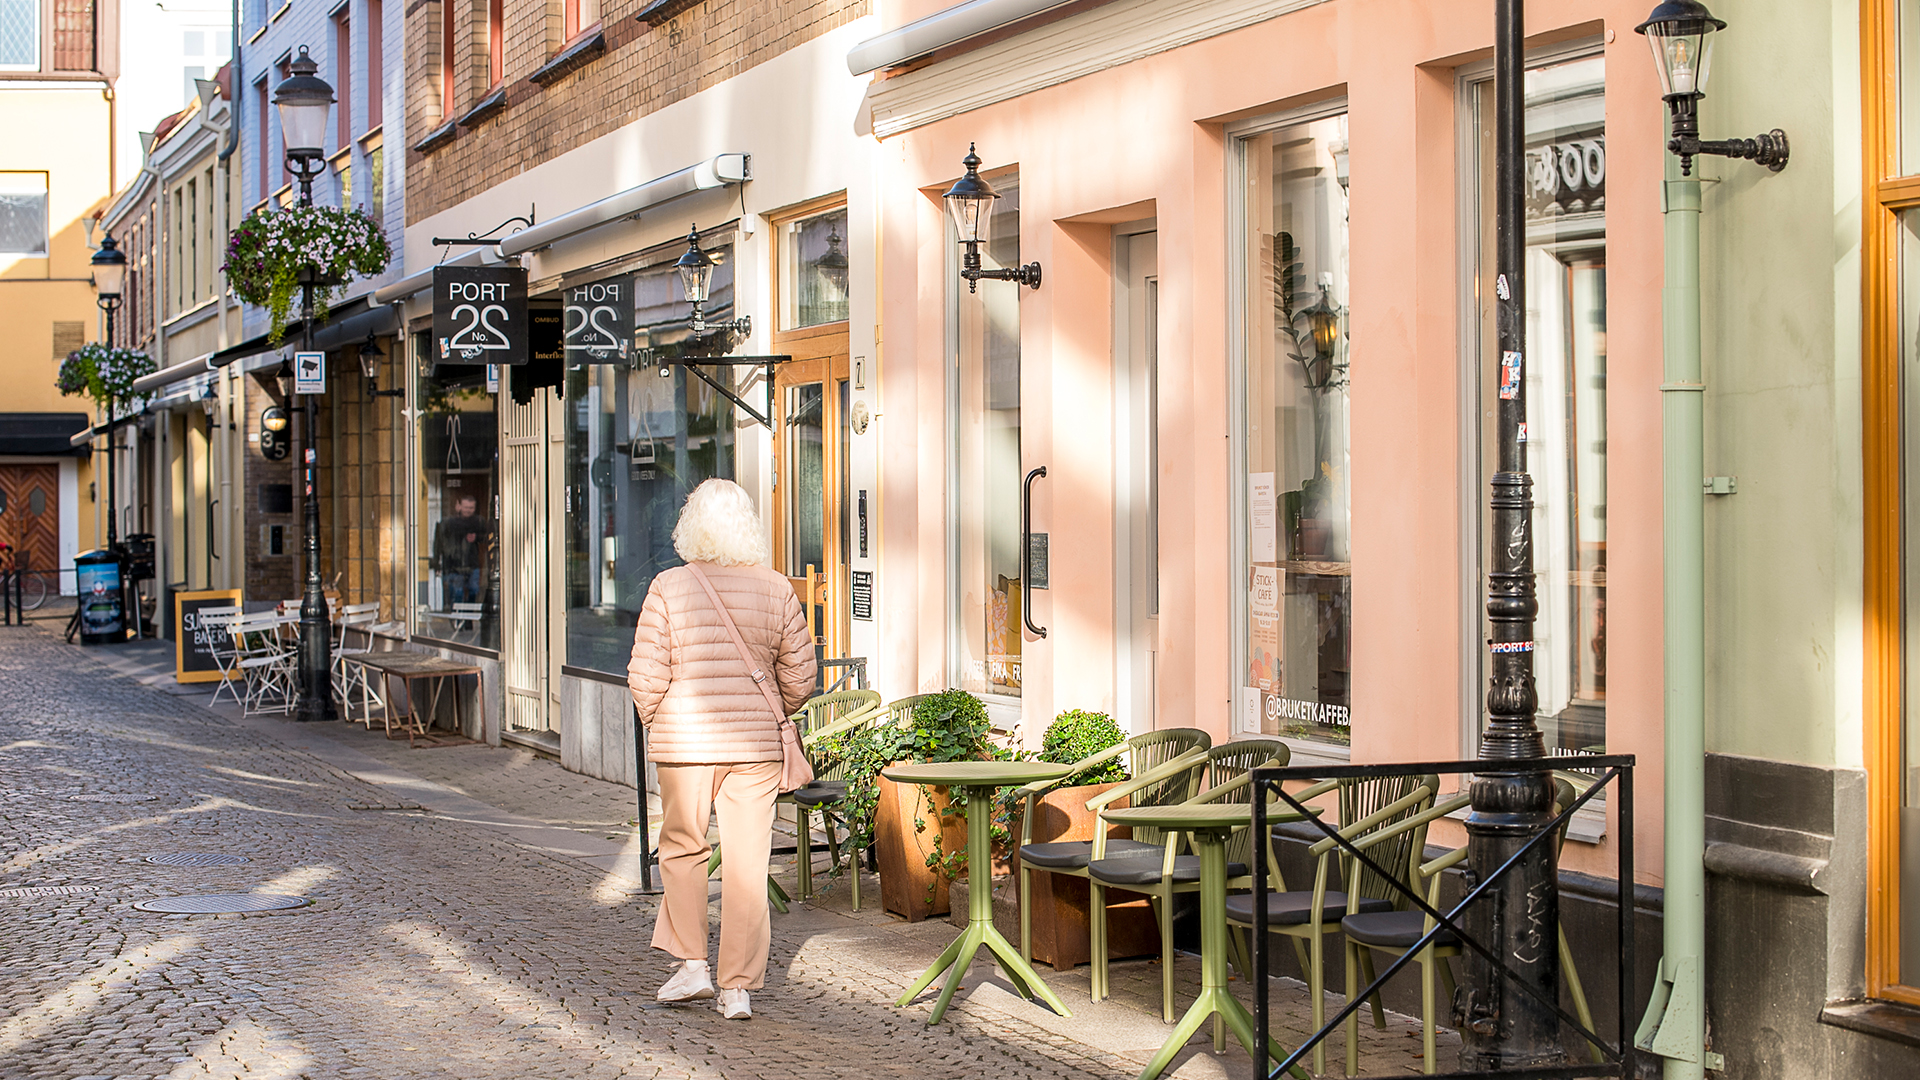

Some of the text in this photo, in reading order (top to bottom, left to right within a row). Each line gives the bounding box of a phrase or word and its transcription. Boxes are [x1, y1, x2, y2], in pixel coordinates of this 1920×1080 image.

[449, 282, 511, 301] PORT
[471, 332, 488, 341] No.
[1256, 575, 1274, 586] STICK-
[1257, 588, 1272, 600] CAFÉ
[194, 629, 227, 645] BAERI
[992, 661, 1007, 679] FIKA
[1265, 694, 1351, 727] @BRUKETKAFFEB
